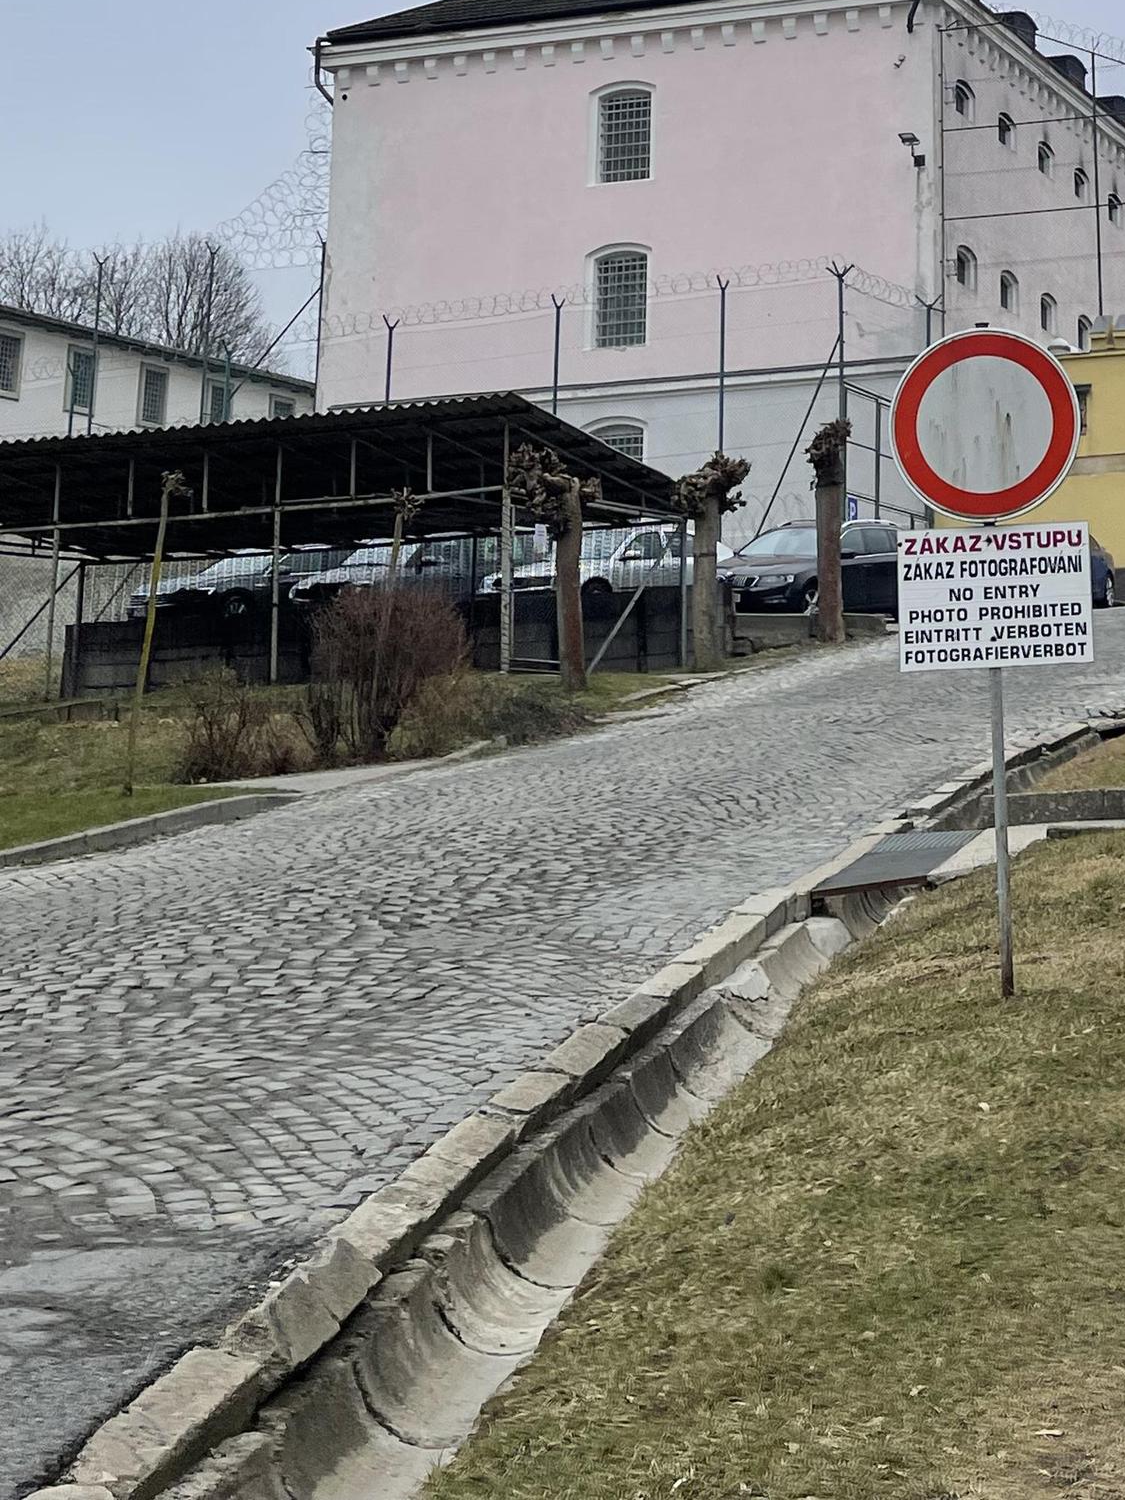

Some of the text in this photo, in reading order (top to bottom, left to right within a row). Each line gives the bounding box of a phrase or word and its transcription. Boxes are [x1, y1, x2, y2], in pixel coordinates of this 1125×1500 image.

[904, 529, 1082, 555] ZÁKAZ VSTUPU
[903, 549, 1083, 581] ZÁKAZ FOTOGRAFOVÁNÍ
[949, 584, 1040, 602] NO ENTRY
[909, 602, 1082, 624] PHOTO PROHIBITED
[904, 622, 1087, 644] EINTRITT VERBOTEN
[904, 642, 1087, 665] FOTOGRAFIERVERBOT
